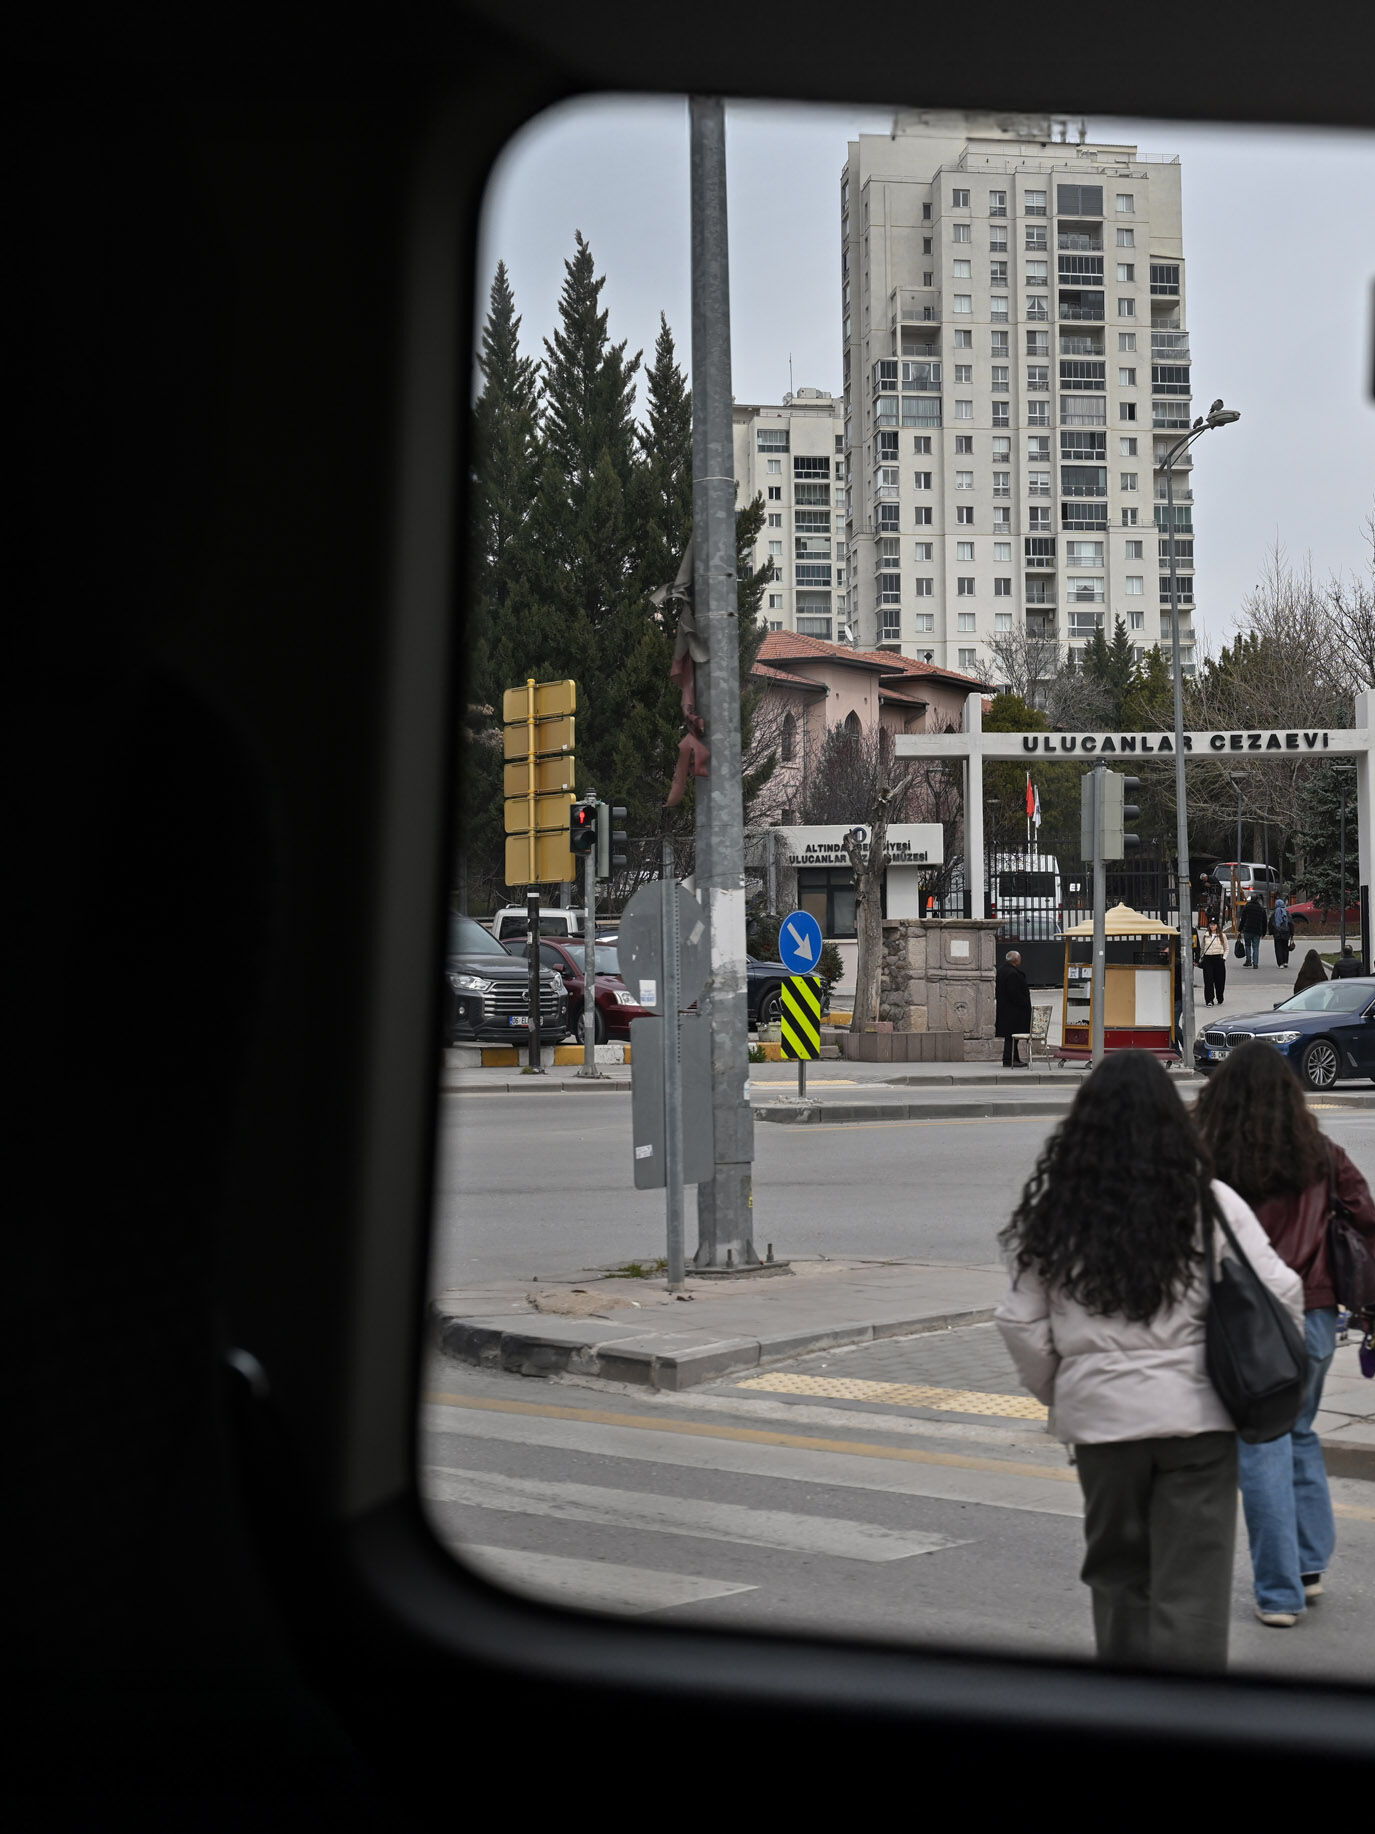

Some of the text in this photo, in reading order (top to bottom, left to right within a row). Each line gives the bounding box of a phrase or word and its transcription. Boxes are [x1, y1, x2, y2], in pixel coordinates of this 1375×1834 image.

[1022, 732, 1329, 753] ULUCANLAR CEZAEVİ
[805, 843, 850, 854] ALTINDA
[789, 854, 847, 865] ULUCANLAR
[892, 850, 929, 862] MÜZESİ
